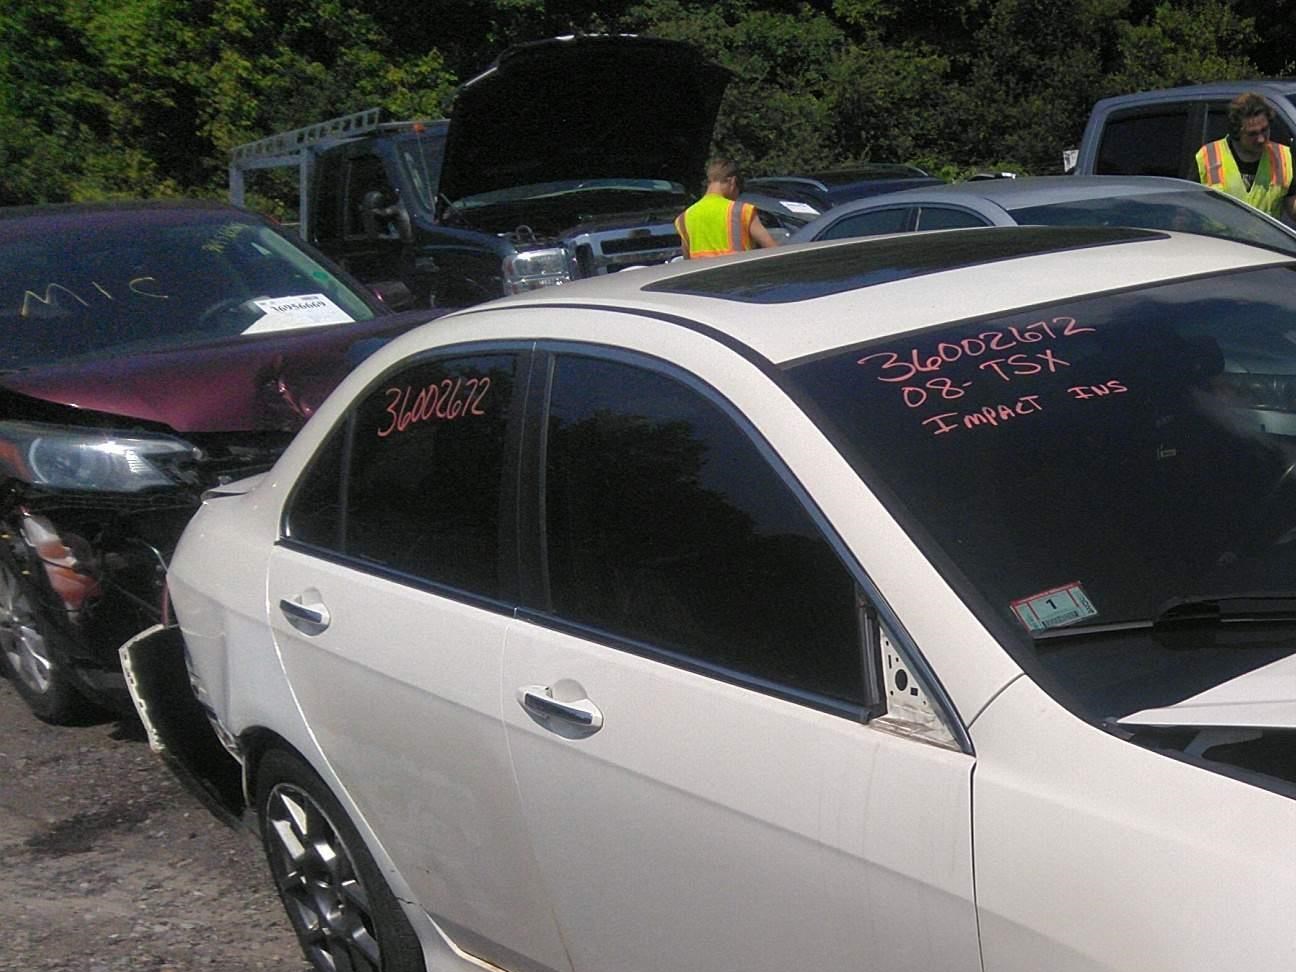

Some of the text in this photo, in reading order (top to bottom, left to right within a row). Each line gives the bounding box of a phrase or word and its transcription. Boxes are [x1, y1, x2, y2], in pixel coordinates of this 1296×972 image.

[857, 316, 1096, 382] 36002672
[377, 377, 490, 437] 36002672
[1067, 379, 1128, 399] INS
